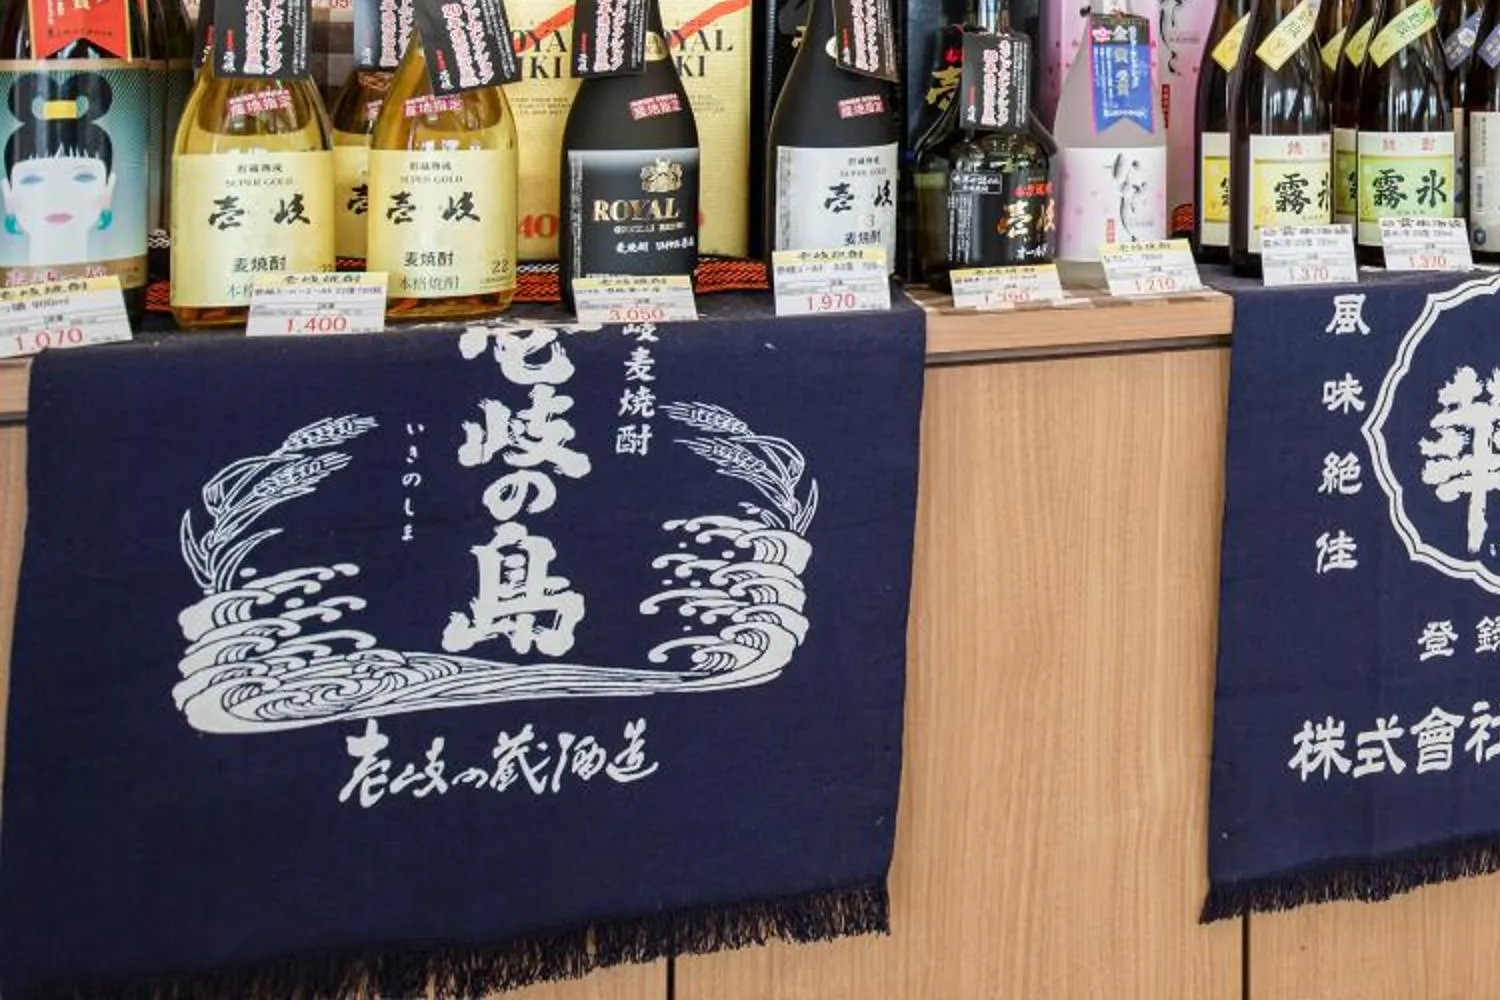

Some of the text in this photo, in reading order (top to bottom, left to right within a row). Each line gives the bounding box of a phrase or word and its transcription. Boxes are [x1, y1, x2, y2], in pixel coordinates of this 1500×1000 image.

[823, 179, 894, 214] 壱岐
[1373, 168, 1447, 209] 霧氷
[208, 193, 312, 231] 壱岐
[386, 191, 481, 224] 壱岐
[593, 197, 679, 221] ROYAL
[519, 213, 558, 239] 40
[403, 251, 454, 269] 麦焼酎
[807, 292, 857, 312] 1,970
[286, 316, 347, 334] 1,400
[1315, 293, 1372, 574] 風味絶佳
[401, 423, 424, 542] いきのしま
[338, 716, 660, 809] 壱岐の蔵酒造
